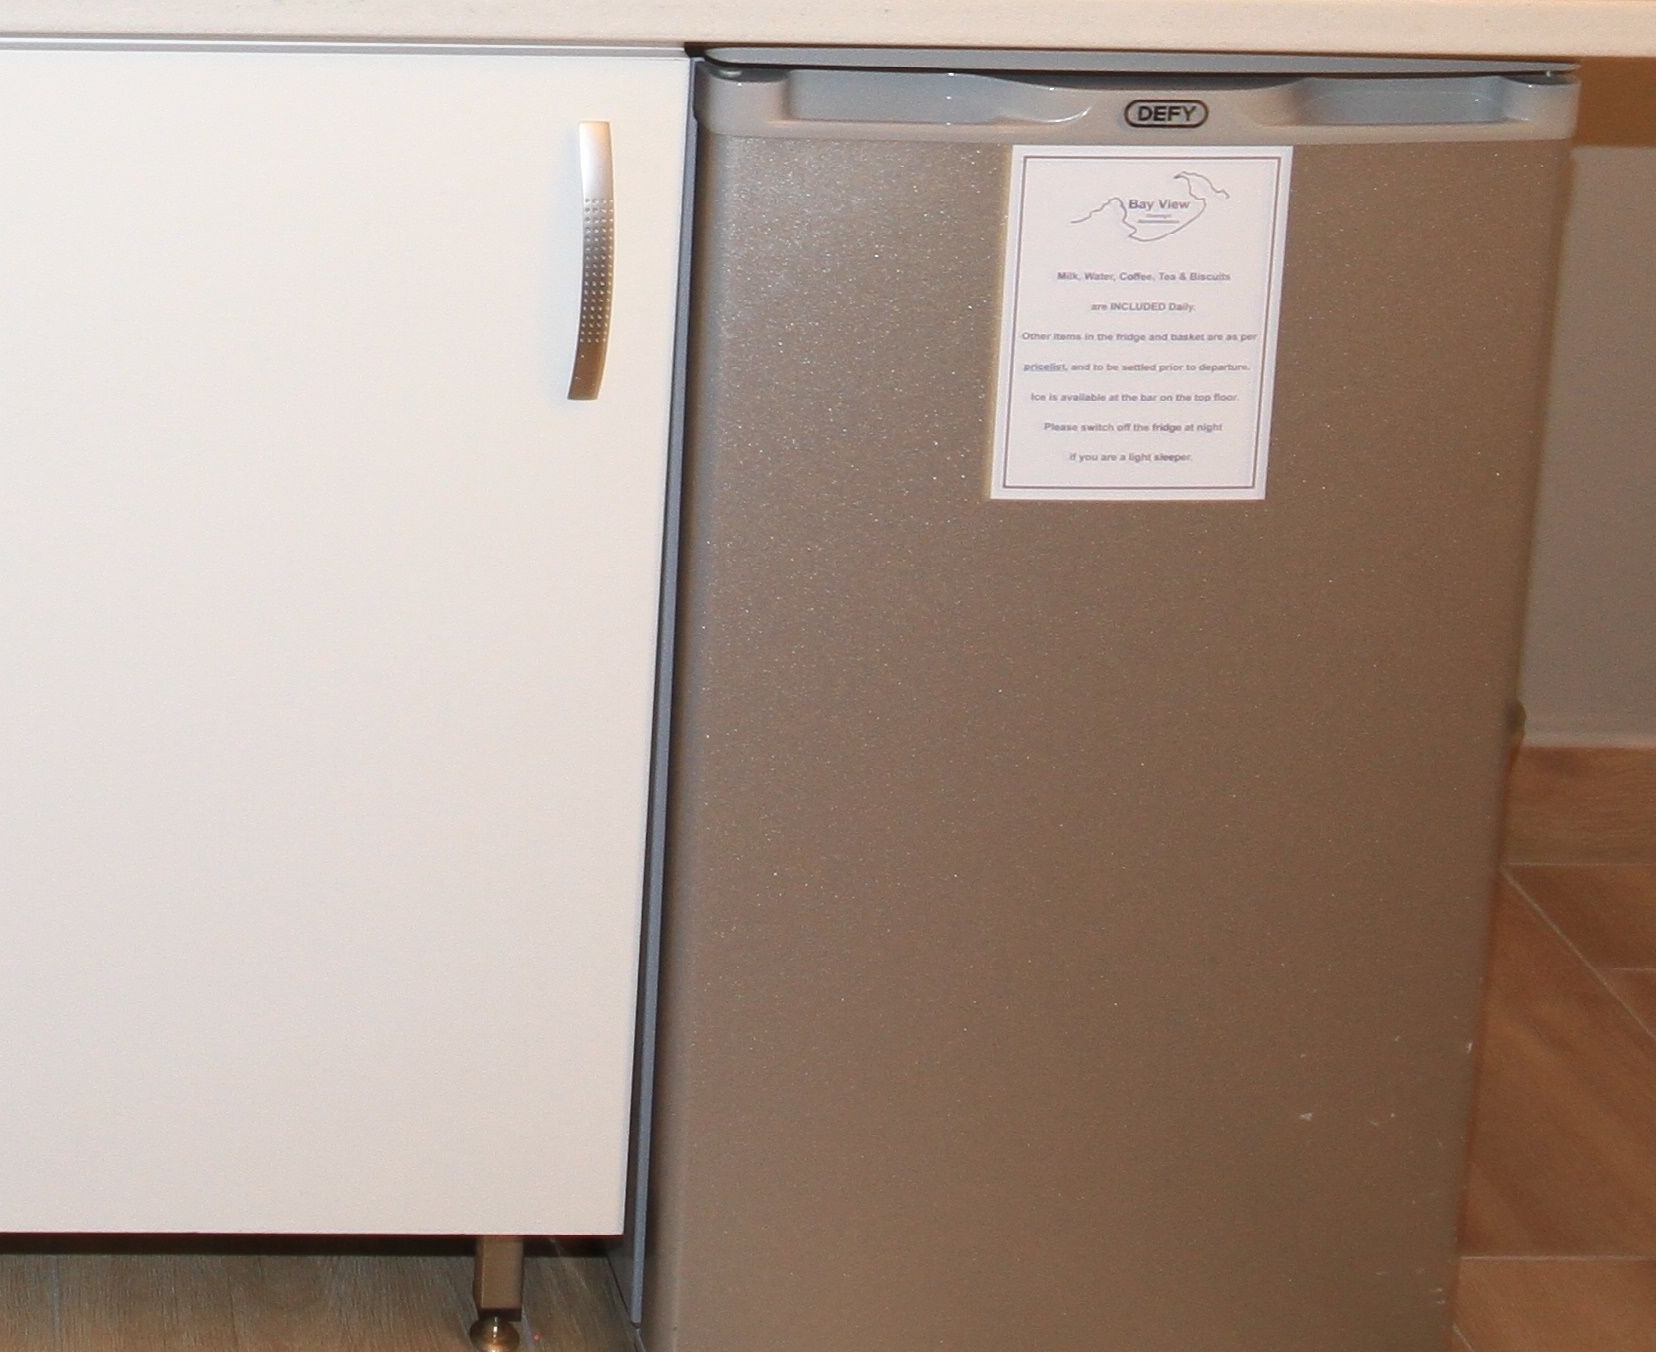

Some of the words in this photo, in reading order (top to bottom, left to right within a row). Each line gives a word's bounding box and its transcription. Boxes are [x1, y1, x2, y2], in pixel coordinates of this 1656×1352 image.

[1137, 105, 1197, 121] DEFY
[1128, 199, 1155, 211] Bay
[1158, 199, 1191, 209] View
[1159, 272, 1176, 281] Tea
[1178, 272, 1187, 281] &
[1189, 272, 1231, 281] Biscuits
[1110, 303, 1166, 311] INCLUDED
[1022, 332, 1051, 341] Other
[1084, 332, 1094, 341] in
[1097, 333, 1113, 341] the
[1116, 333, 1145, 344] fridge
[1149, 333, 1168, 341] and
[1170, 333, 1205, 341] basket
[1240, 334, 1258, 344] per
[1070, 363, 1091, 371] and
[1093, 363, 1104, 371] to
[1106, 363, 1120, 371] be
[1122, 363, 1157, 371] settled
[1159, 363, 1184, 374] prior
[1031, 393, 1046, 401] Ice
[1049, 392, 1058, 401] is
[1060, 393, 1106, 401] available
[1121, 393, 1138, 401] the
[1140, 393, 1157, 402] bar
[1175, 394, 1192, 402] the
[1194, 394, 1211, 404] top
[1043, 422, 1078, 431] Please
[1081, 422, 1114, 432] switch
[1116, 423, 1131, 432] off
[1133, 423, 1150, 432] the
[1152, 423, 1182, 433] fridge
[1184, 424, 1194, 432] at
[1197, 423, 1222, 433] night
[1079, 455, 1098, 463] you
[1128, 453, 1152, 463] light
